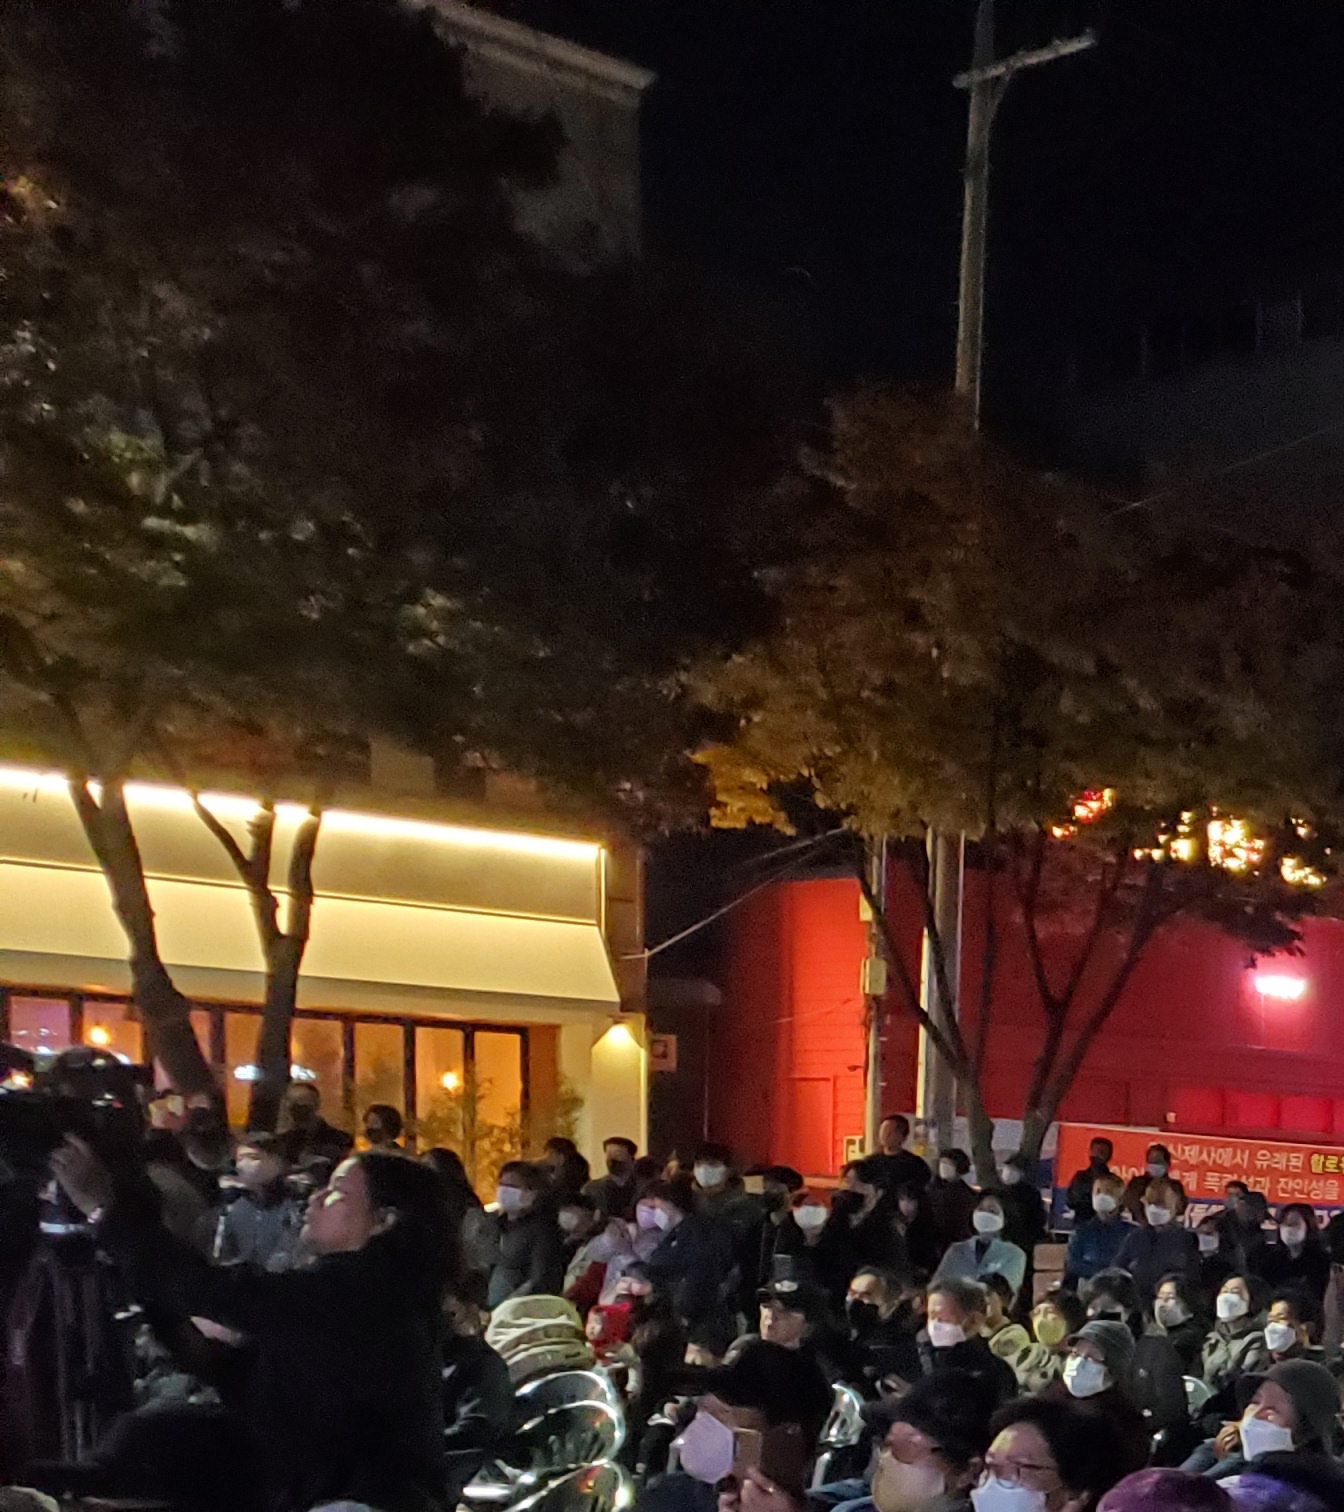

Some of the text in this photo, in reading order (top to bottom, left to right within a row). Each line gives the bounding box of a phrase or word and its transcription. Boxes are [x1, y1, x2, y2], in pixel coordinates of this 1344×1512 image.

[1149, 1141, 1250, 1169] 신제사에서
[1255, 1148, 1304, 1173] 유래된
[1277, 1177, 1340, 1201] 잔인성을
